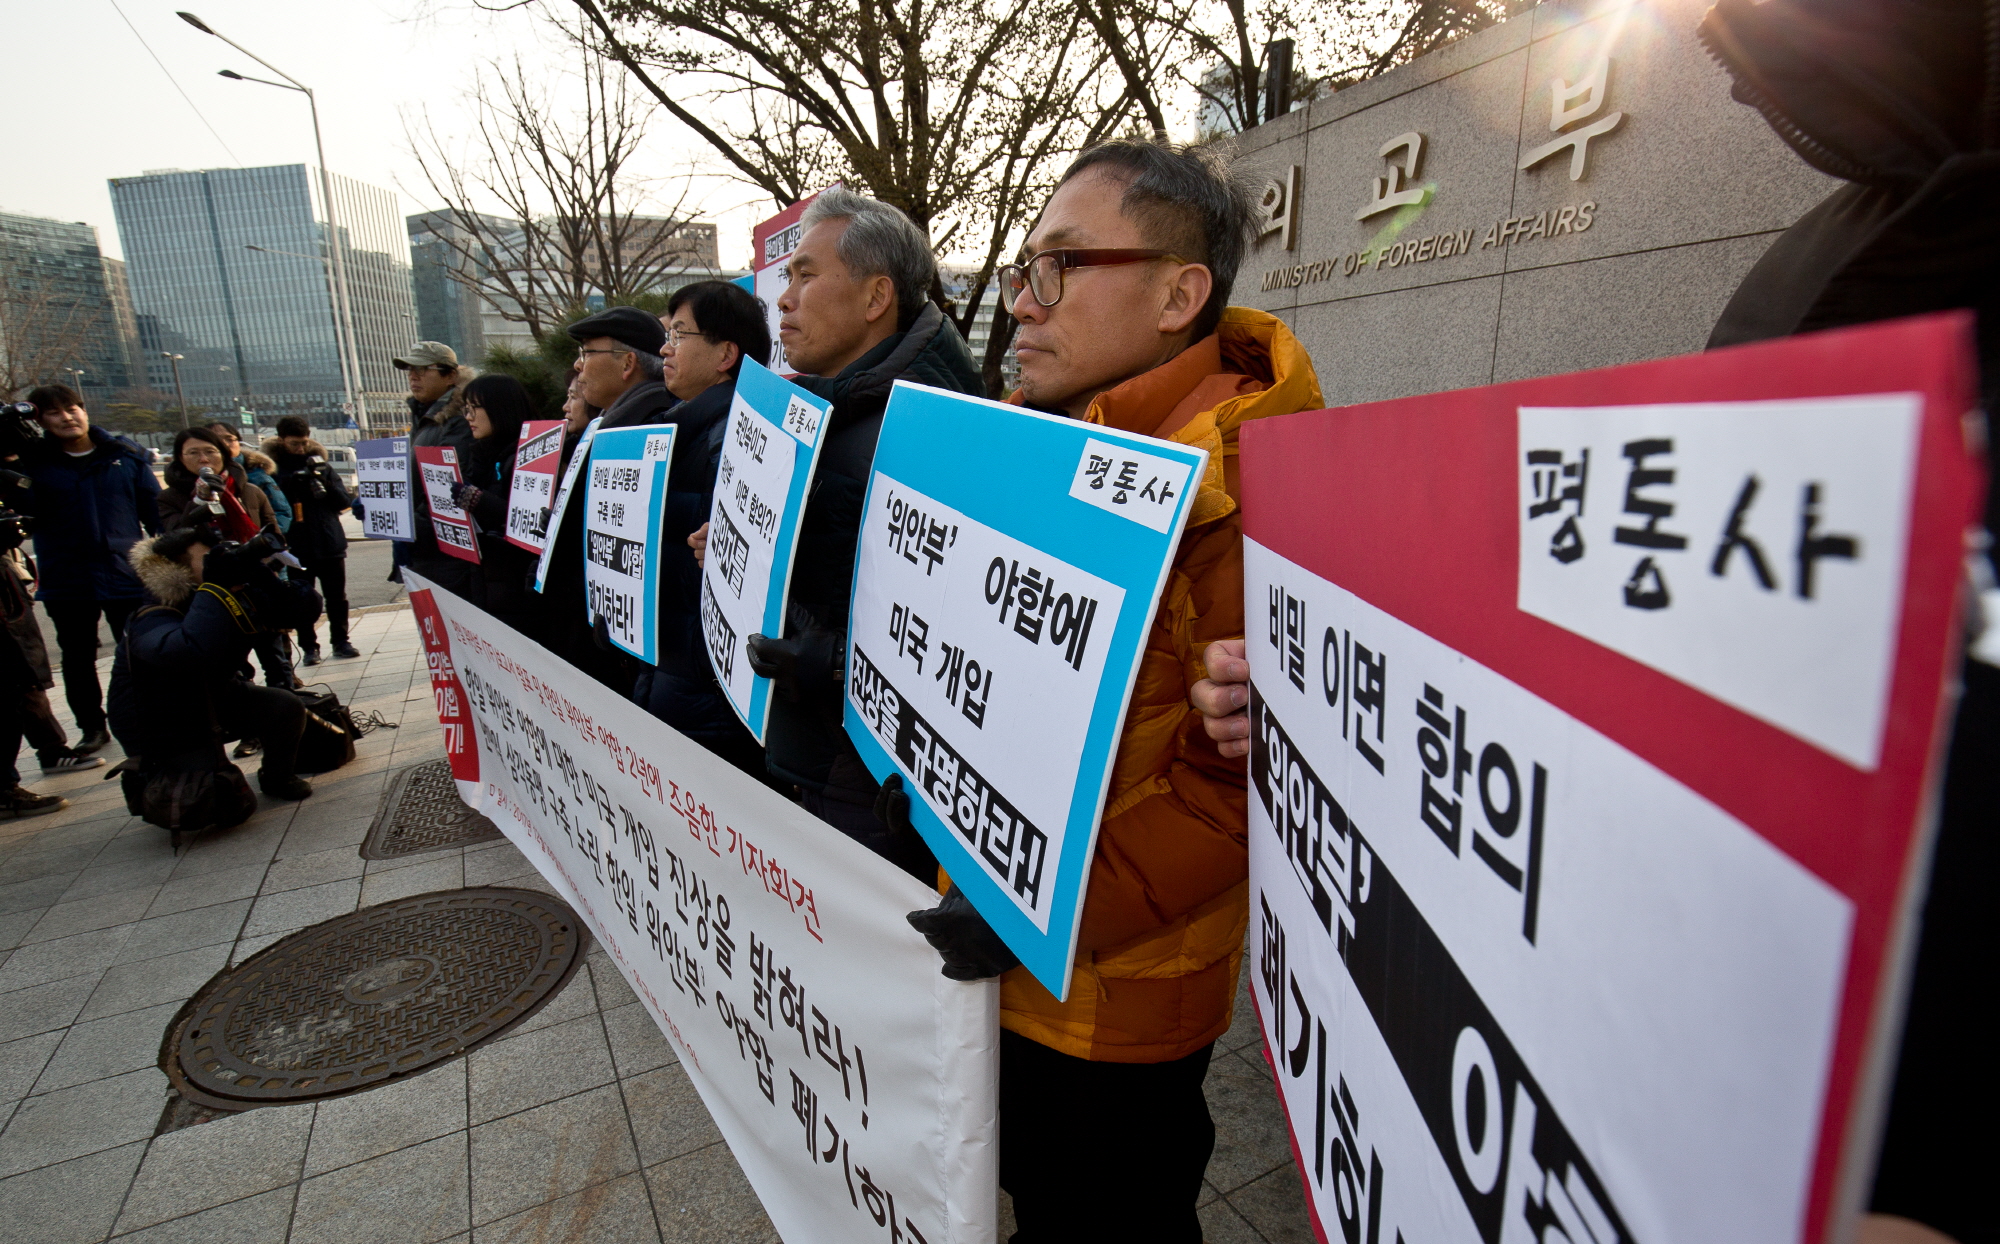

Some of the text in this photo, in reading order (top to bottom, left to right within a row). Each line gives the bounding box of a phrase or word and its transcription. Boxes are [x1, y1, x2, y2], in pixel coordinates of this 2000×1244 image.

[1261, 200, 1597, 292] MINISTRY OF FOREIGN AFFAIRS
[647, 439, 668, 457] 평통사
[789, 403, 816, 435] 평통사
[378, 482, 390, 498] 개입
[393, 482, 406, 499] 진상
[594, 466, 641, 492] 한미일 삼각동맹
[736, 479, 749, 514] 이면
[748, 493, 777, 545] 합의?!
[1084, 453, 1175, 506] 평통사
[370, 510, 399, 534] 밝혀라!
[597, 501, 625, 527] 구축 위한
[1526, 437, 1862, 611] 평통사
[590, 531, 617, 570] '위안부'
[622, 543, 643, 580] 야합
[886, 490, 1098, 671] '위안부' 야합에
[588, 579, 635, 644] 폐기하라!
[889, 602, 993, 730] 미국 개입
[852, 651, 1045, 910] 진상을 규명하라!
[1268, 582, 1549, 948] 비밀 이면 합의
[514, 662, 534, 693] 발표
[532, 675, 547, 707] 및
[542, 681, 566, 723] 한일
[597, 725, 625, 775] 야합
[625, 745, 664, 805] 2년에
[668, 779, 721, 858] 즈음한
[726, 825, 823, 945] 기자회견
[464, 665, 486, 713] 한일
[516, 708, 553, 770] 야합에
[551, 739, 584, 807] 대한
[582, 769, 617, 844] 미국
[618, 804, 660, 892] 개입
[665, 846, 736, 981] 진상을
[749, 930, 869, 1132] 밝혀라!
[506, 741, 547, 817] 삼각동맹
[547, 785, 574, 848] 구축
[575, 815, 605, 888] 노린
[605, 849, 639, 935] 한일
[715, 990, 776, 1107] 야합
[788, 1067, 928, 1244] 폐기하
